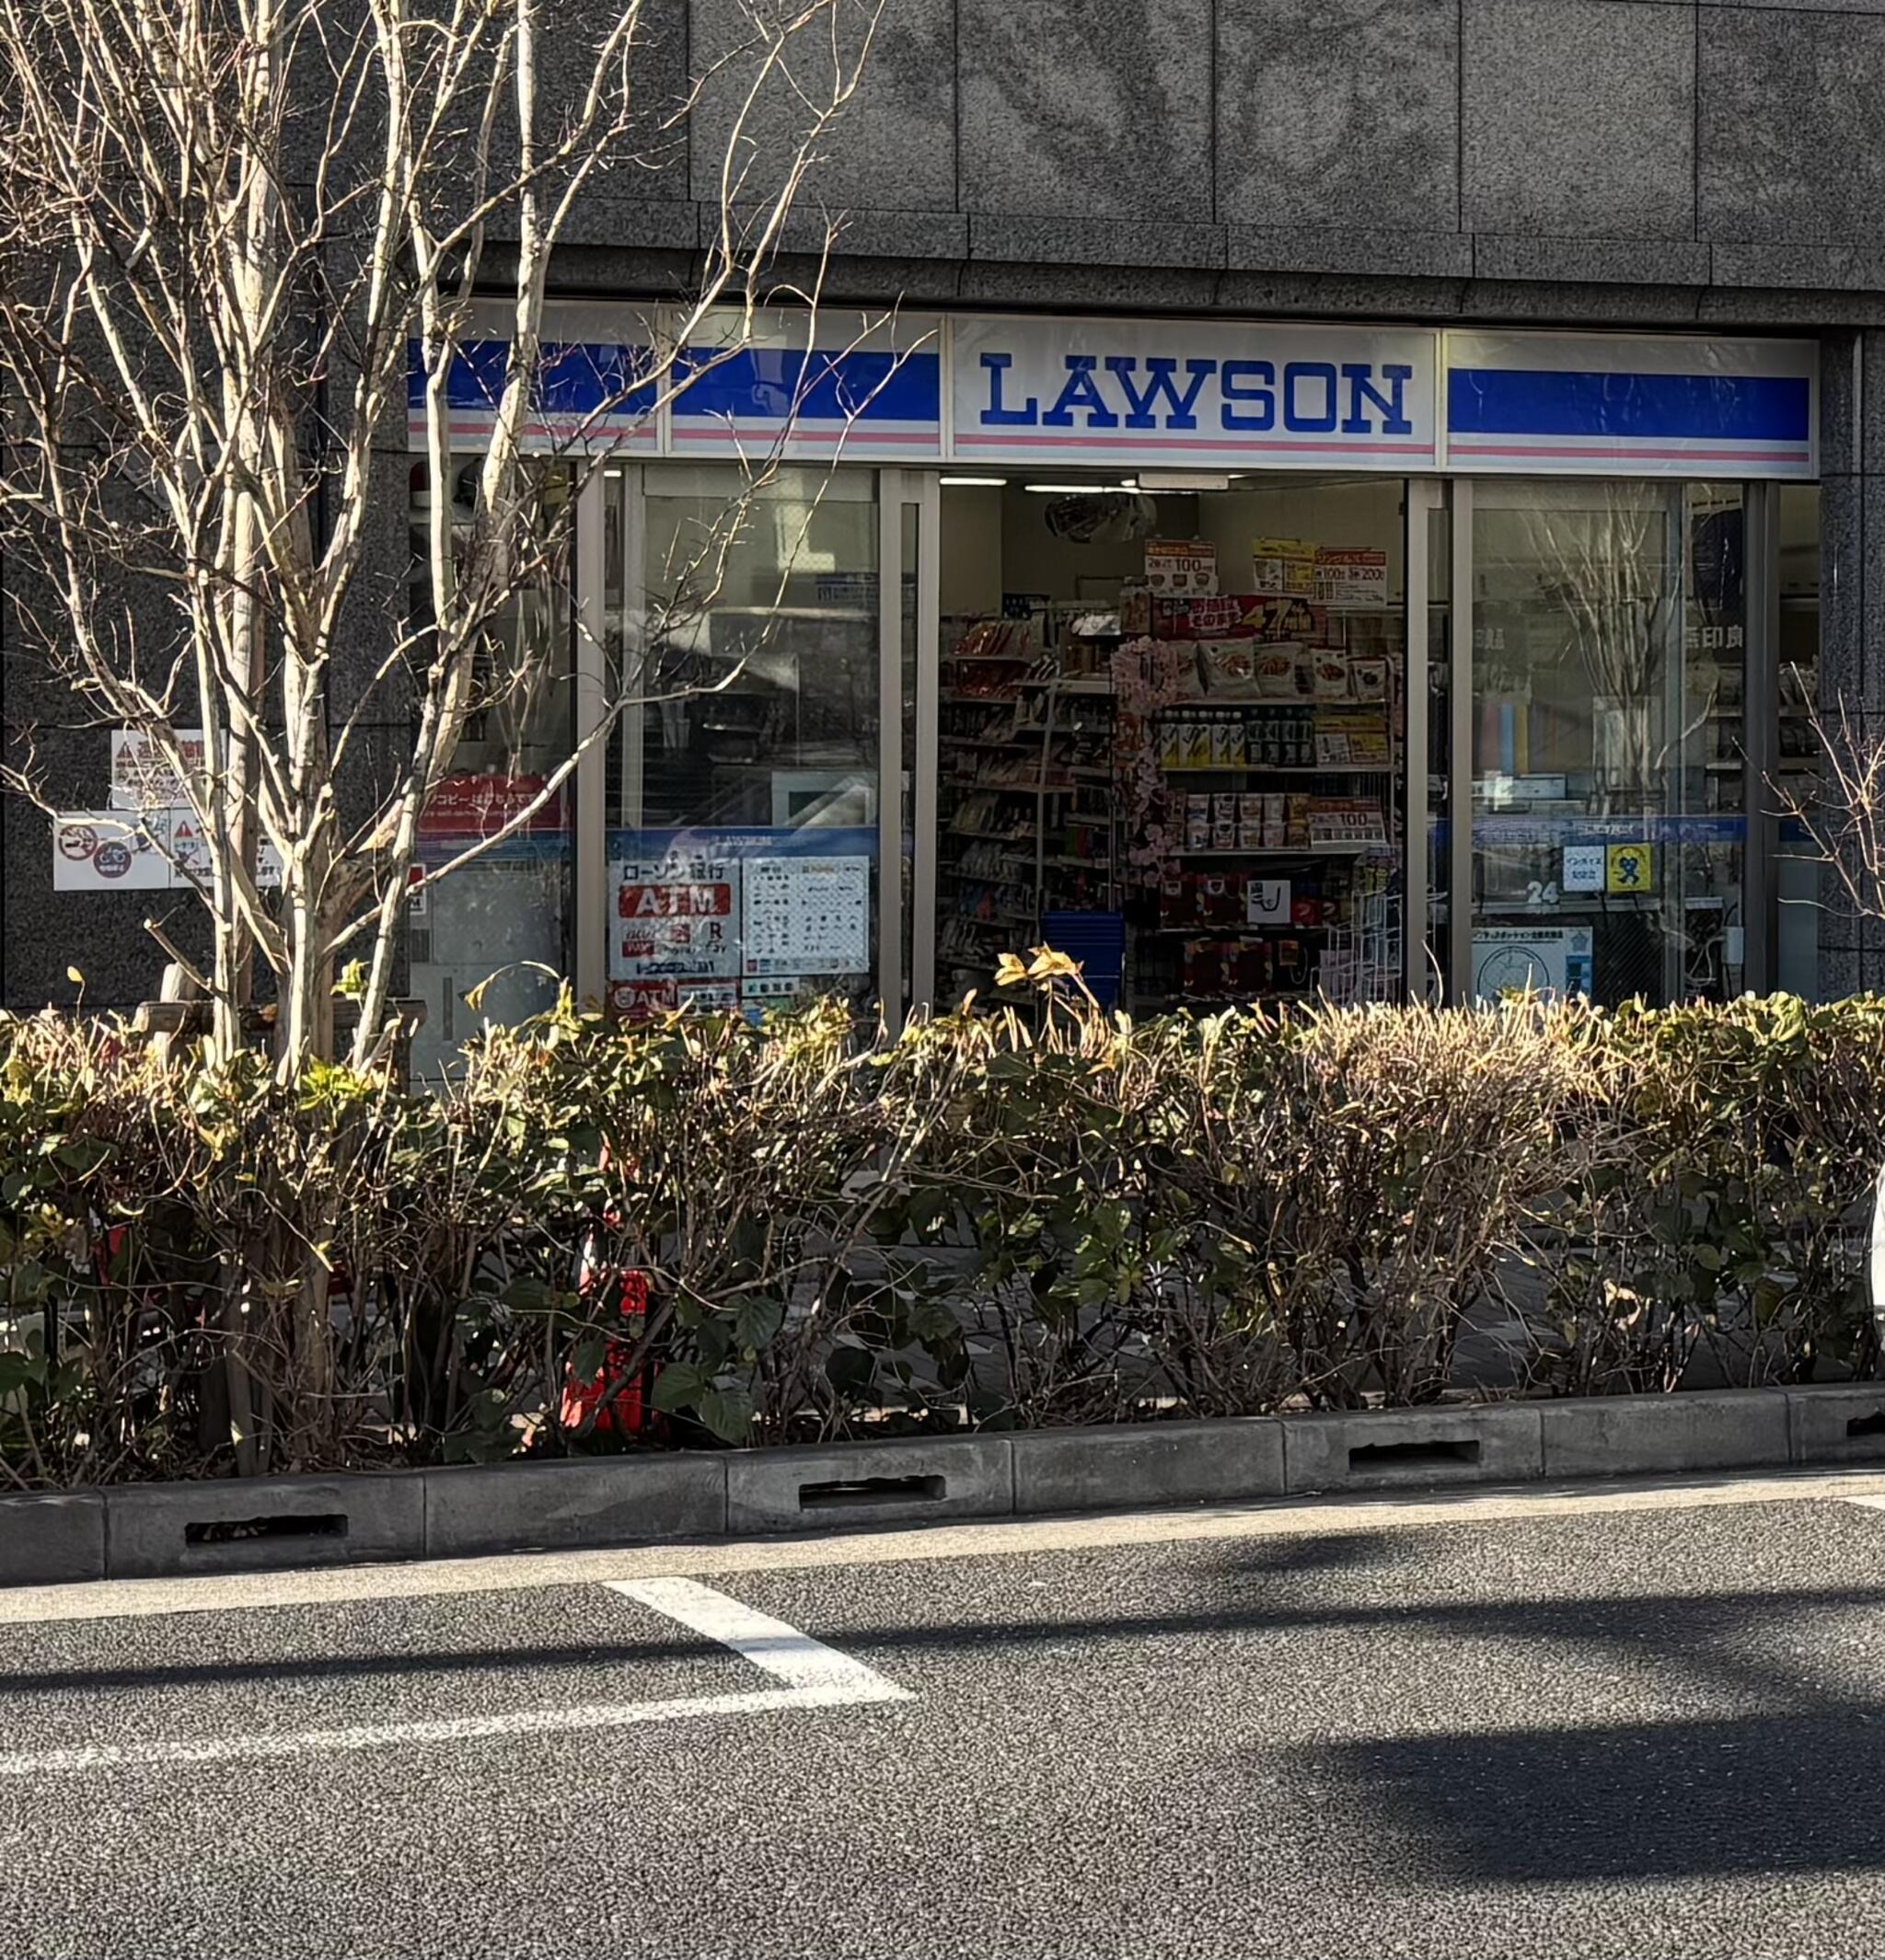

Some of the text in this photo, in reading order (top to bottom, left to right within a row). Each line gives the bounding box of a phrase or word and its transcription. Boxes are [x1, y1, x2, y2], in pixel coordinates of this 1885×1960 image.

[980, 352, 1413, 434] LAWSON
[1175, 558, 1201, 571] 100
[1243, 599, 1292, 629] 47
[1341, 813, 1367, 826] 100
[635, 885, 716, 915] ATM
[1527, 881, 1559, 904] 24
